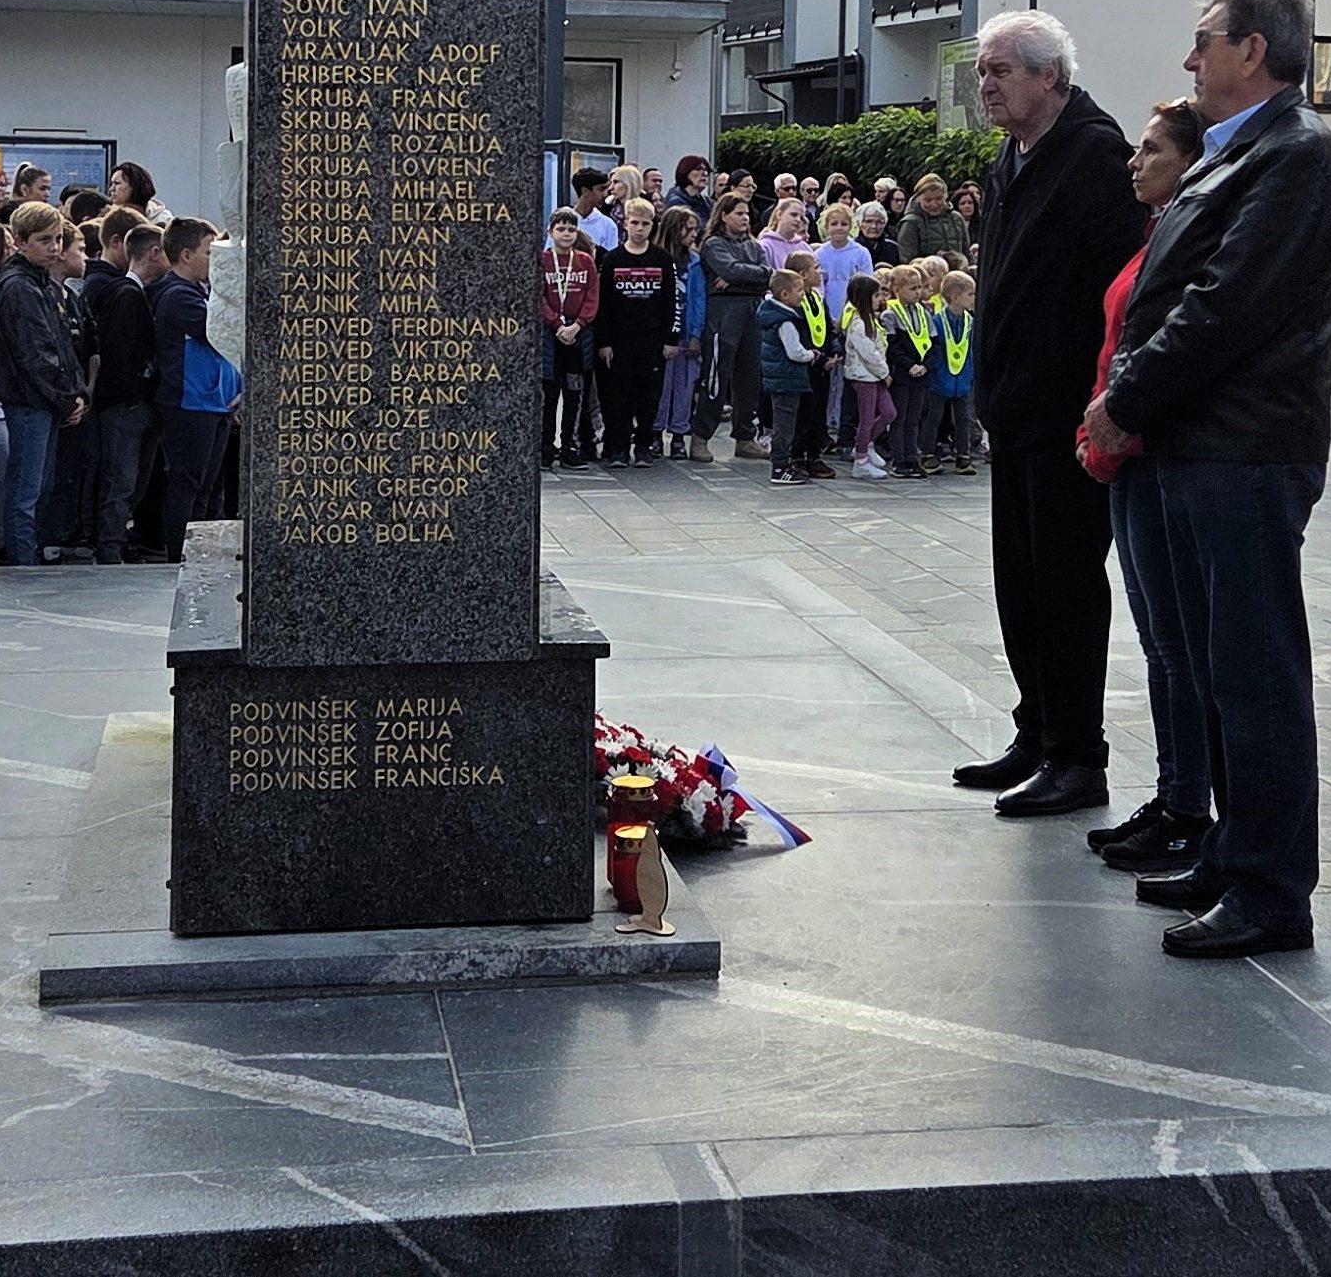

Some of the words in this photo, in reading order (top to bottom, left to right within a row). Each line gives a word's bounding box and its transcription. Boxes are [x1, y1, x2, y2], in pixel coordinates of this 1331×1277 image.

[282, 19, 341, 38] VOLK
[361, 20, 420, 39] IVAN
[281, 43, 410, 61] MRAVLJAK
[429, 44, 501, 63] ADOLF
[281, 60, 398, 85] HRIBERŠEK
[418, 67, 482, 85] NACE
[281, 84, 372, 107] ŠKRUBA
[392, 89, 471, 108] FRANC
[281, 109, 371, 130] ŠKRUBA
[392, 112, 491, 131] VINCENC
[281, 132, 371, 153] ŠKRUBA
[392, 135, 503, 154] ROZALIJA
[281, 154, 371, 177] ŠKRUBA
[392, 157, 495, 177] LOVRENC
[281, 177, 371, 199] ŠKRUBA
[392, 180, 477, 200] MIHAEL
[281, 200, 371, 222] ŠKRUBA
[392, 203, 511, 222] ELIZABETA
[281, 223, 371, 245] ŠKRUBA
[392, 226, 450, 245] IVAN
[281, 249, 359, 268] TAJNIK
[379, 249, 437, 268] IVAN
[281, 273, 359, 291] TAJNIK
[379, 272, 437, 291] IVAN
[281, 294, 359, 313] TAJNIK
[379, 294, 440, 313] MIHA
[280, 318, 373, 336] MEDVED
[392, 318, 520, 336] FERDINAND
[280, 341, 373, 360] MEDVED
[392, 340, 473, 359] VIKTOR
[280, 363, 373, 382] MEDVED
[391, 363, 502, 382] BARBARA
[279, 387, 372, 405] MEDVED
[390, 386, 467, 405] FRANC
[278, 406, 355, 429] LEŠNIK
[375, 405, 430, 429] JOŽE
[278, 429, 402, 452] FRIŠKOVEC
[419, 429, 499, 450] LUDVIK
[277, 452, 392, 474] POTOČNIK
[411, 453, 488, 474] FRANC
[278, 479, 357, 498] TAJNIK
[377, 477, 469, 497] GREGOR
[277, 498, 372, 521] PAVŠAR
[392, 500, 449, 519] IVAN
[279, 524, 357, 544] JAKOB
[376, 523, 455, 543] BOLHA
[230, 696, 357, 722] PODVINŠEK
[375, 696, 463, 717] MARIJA
[230, 720, 357, 745] PODVINŠEK
[375, 720, 453, 741] ZOFIJA
[230, 743, 357, 768] PODVINŠEK
[374, 743, 451, 764] FRANC
[230, 765, 357, 792] PODVINŠEK
[374, 760, 504, 788] FRANČIŠKA
